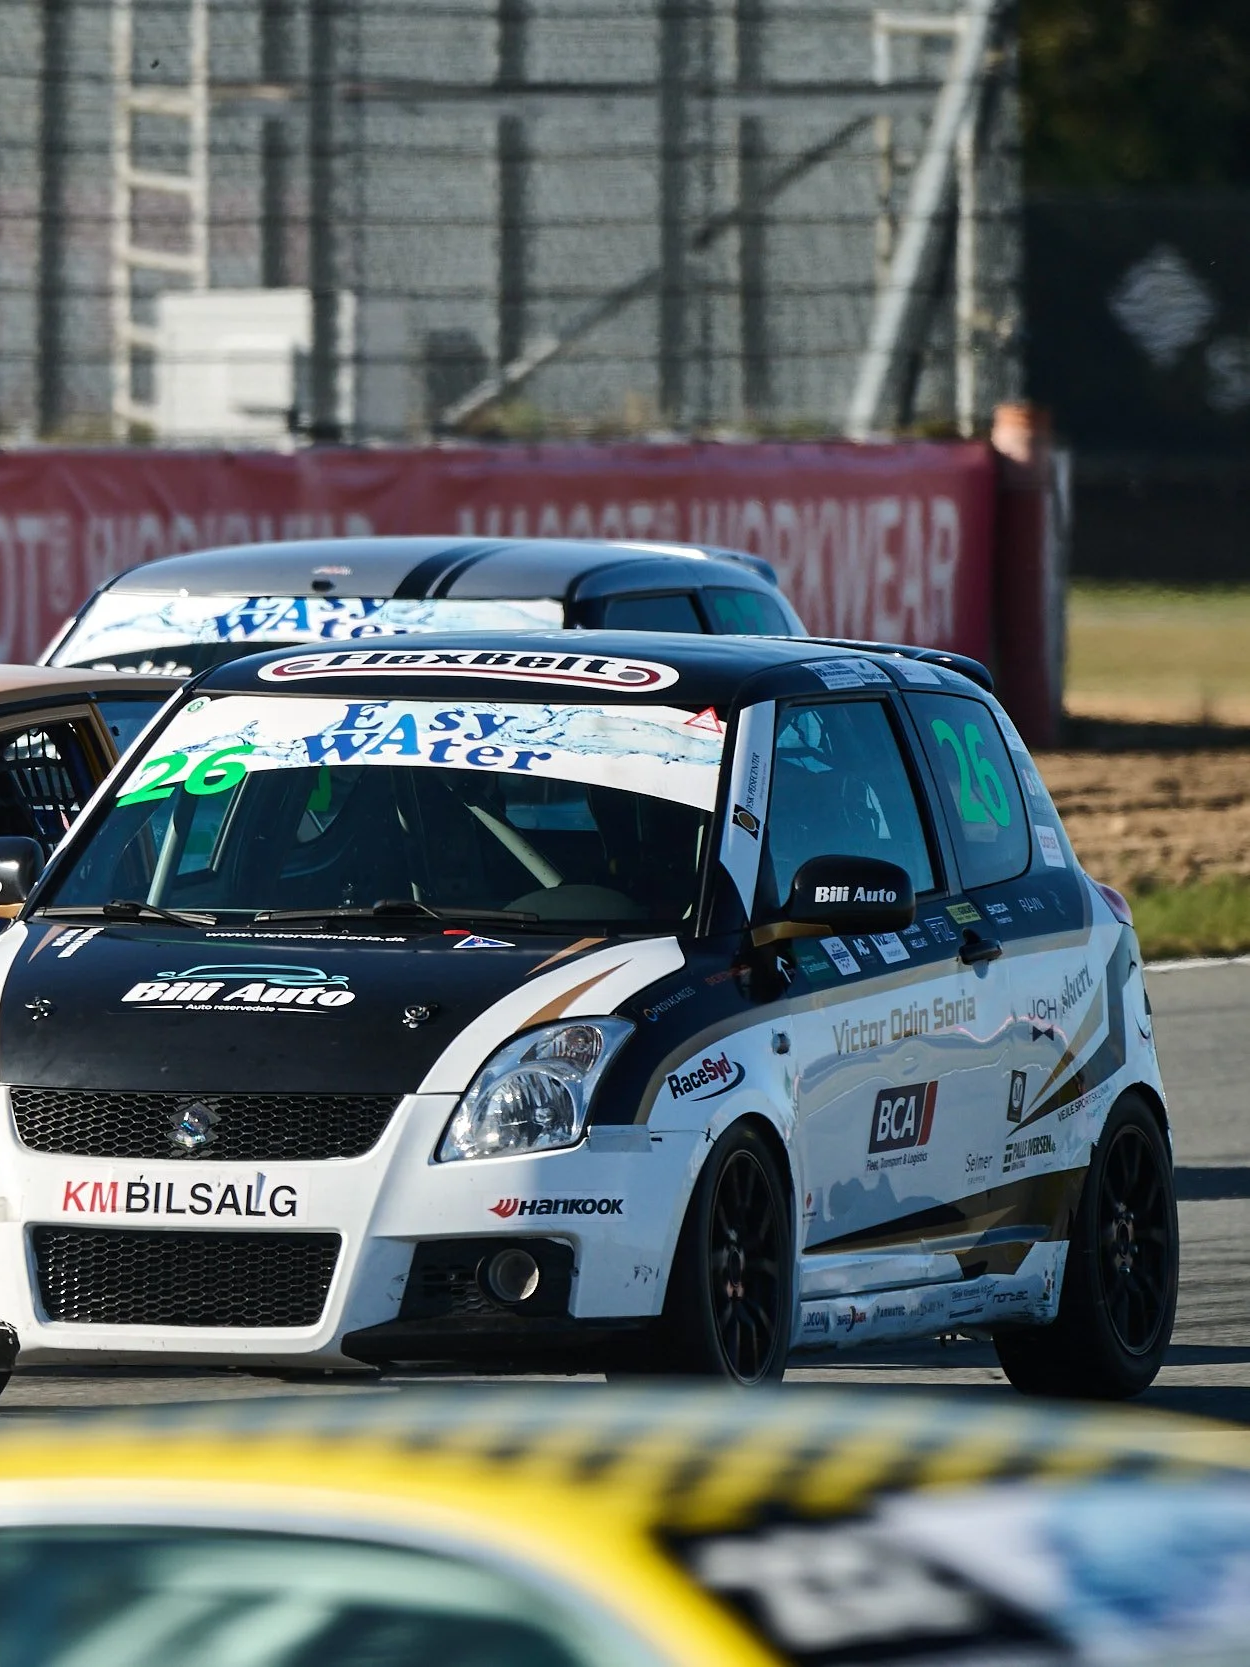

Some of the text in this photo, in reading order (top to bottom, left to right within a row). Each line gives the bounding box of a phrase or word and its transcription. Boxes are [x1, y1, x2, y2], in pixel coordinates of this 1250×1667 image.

[324, 652, 620, 675] FlexBelt
[116, 744, 257, 808] 26
[930, 718, 1011, 827] 26
[814, 886, 897, 903] Bili Auto
[121, 981, 356, 1006] Bili Auto
[185, 1003, 210, 1011] Auto
[1028, 998, 1058, 1020] JCH
[832, 988, 977, 1056] Victor Odin Soria
[667, 1051, 734, 1100] RaceSyd
[876, 1095, 917, 1143] BCA
[964, 1153, 994, 1173] Selmer
